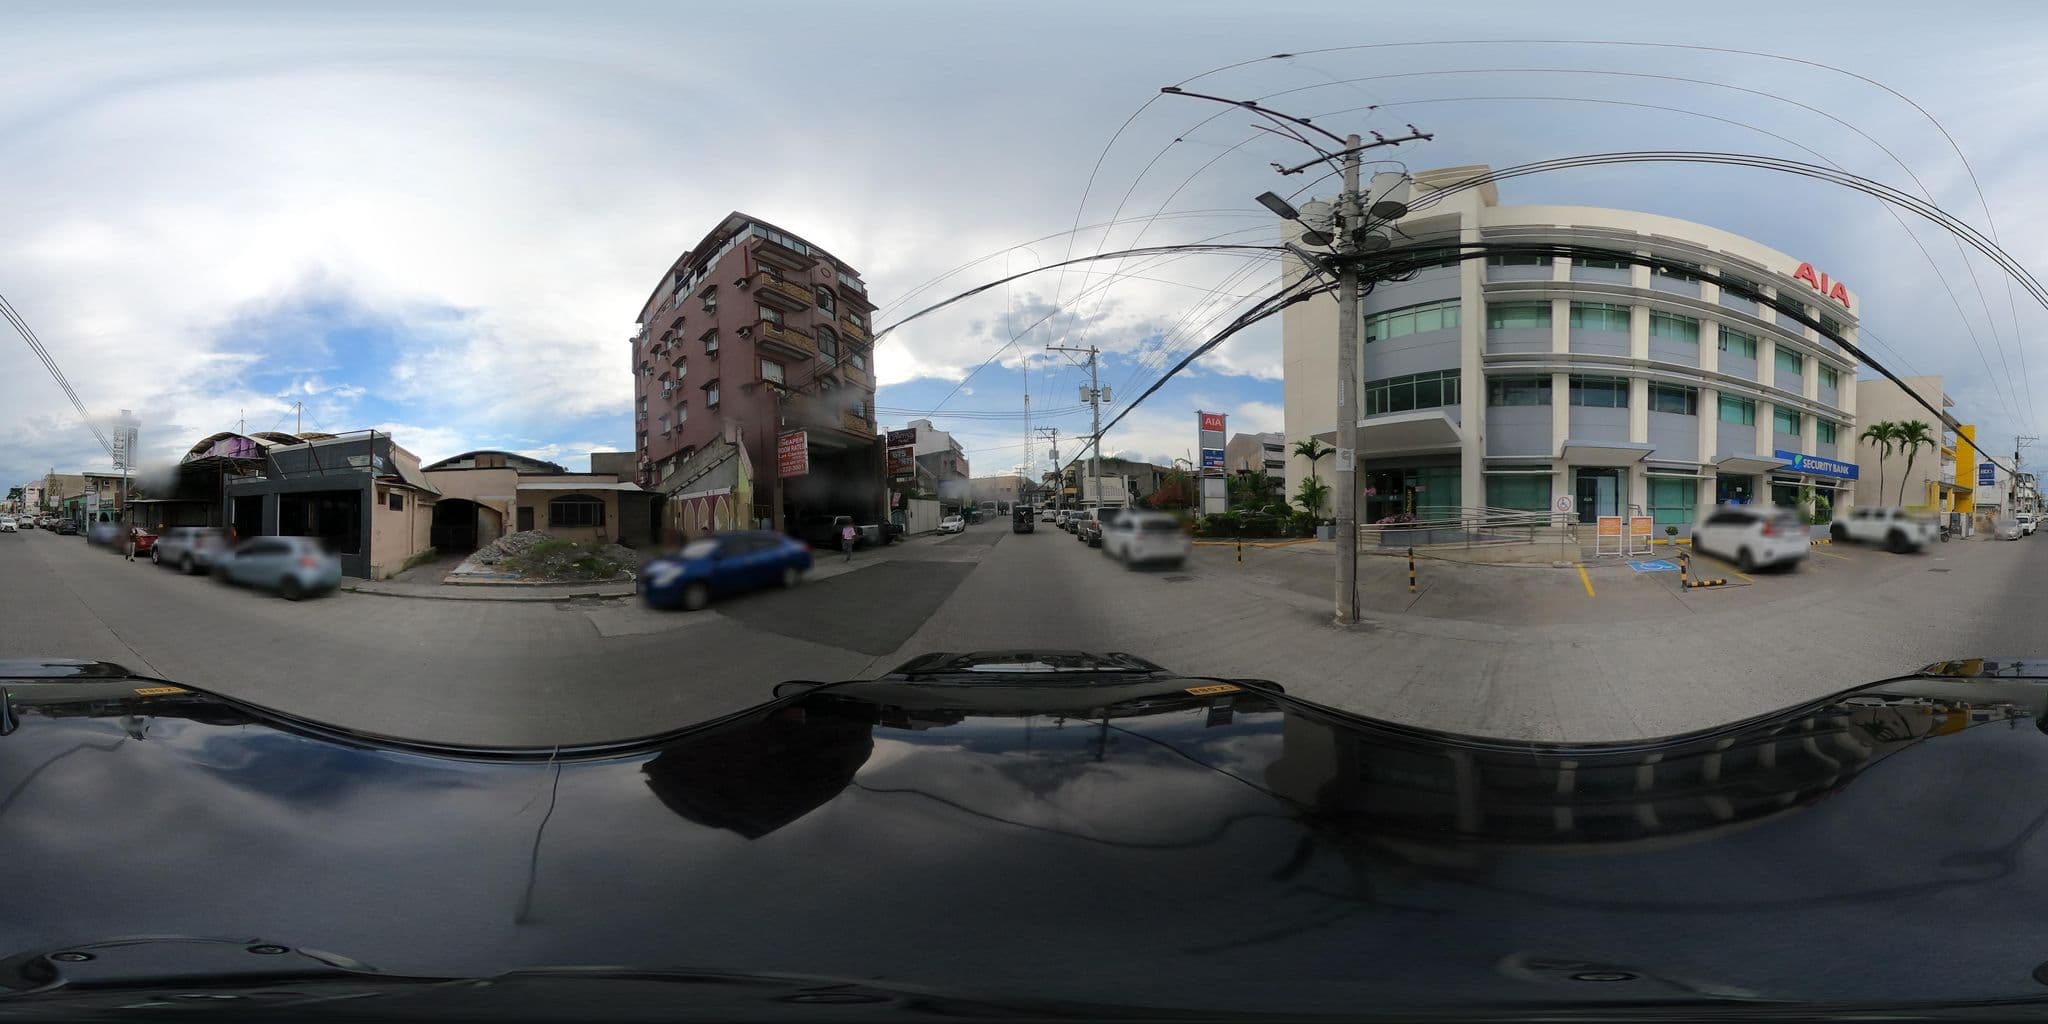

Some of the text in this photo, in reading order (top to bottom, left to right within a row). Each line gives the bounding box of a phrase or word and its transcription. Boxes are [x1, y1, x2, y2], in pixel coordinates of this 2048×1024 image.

[1794, 263, 1851, 307] AIA
[1205, 417, 1222, 426] AIA
[1803, 459, 1849, 474] SECURITY BANK
